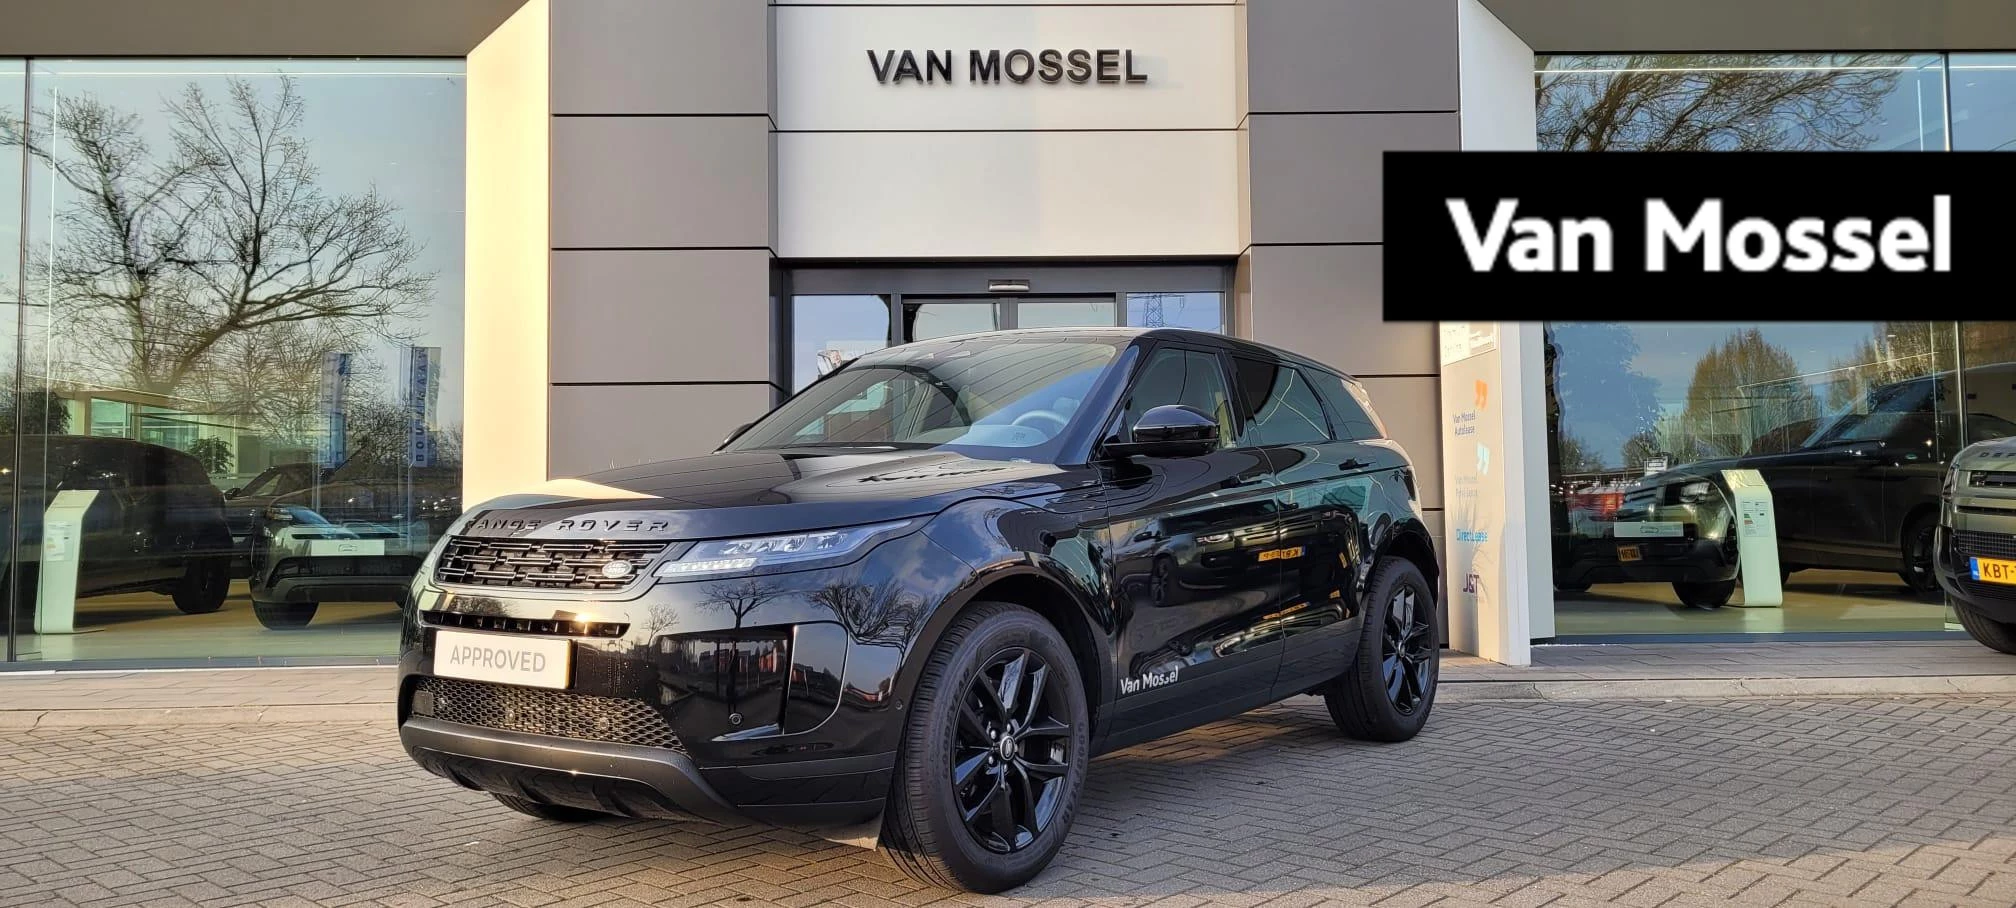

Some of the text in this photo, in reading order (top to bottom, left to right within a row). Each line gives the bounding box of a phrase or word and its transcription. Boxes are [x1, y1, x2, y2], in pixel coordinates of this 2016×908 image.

[866, 48, 1148, 84] VAN MOSSEL
[556, 518, 670, 533] ROVER
[1982, 562, 2016, 581] KBT-
[1463, 573, 1480, 597] J&T
[450, 644, 547, 673] APPROVED
[1120, 665, 1179, 695] Van Mossel
